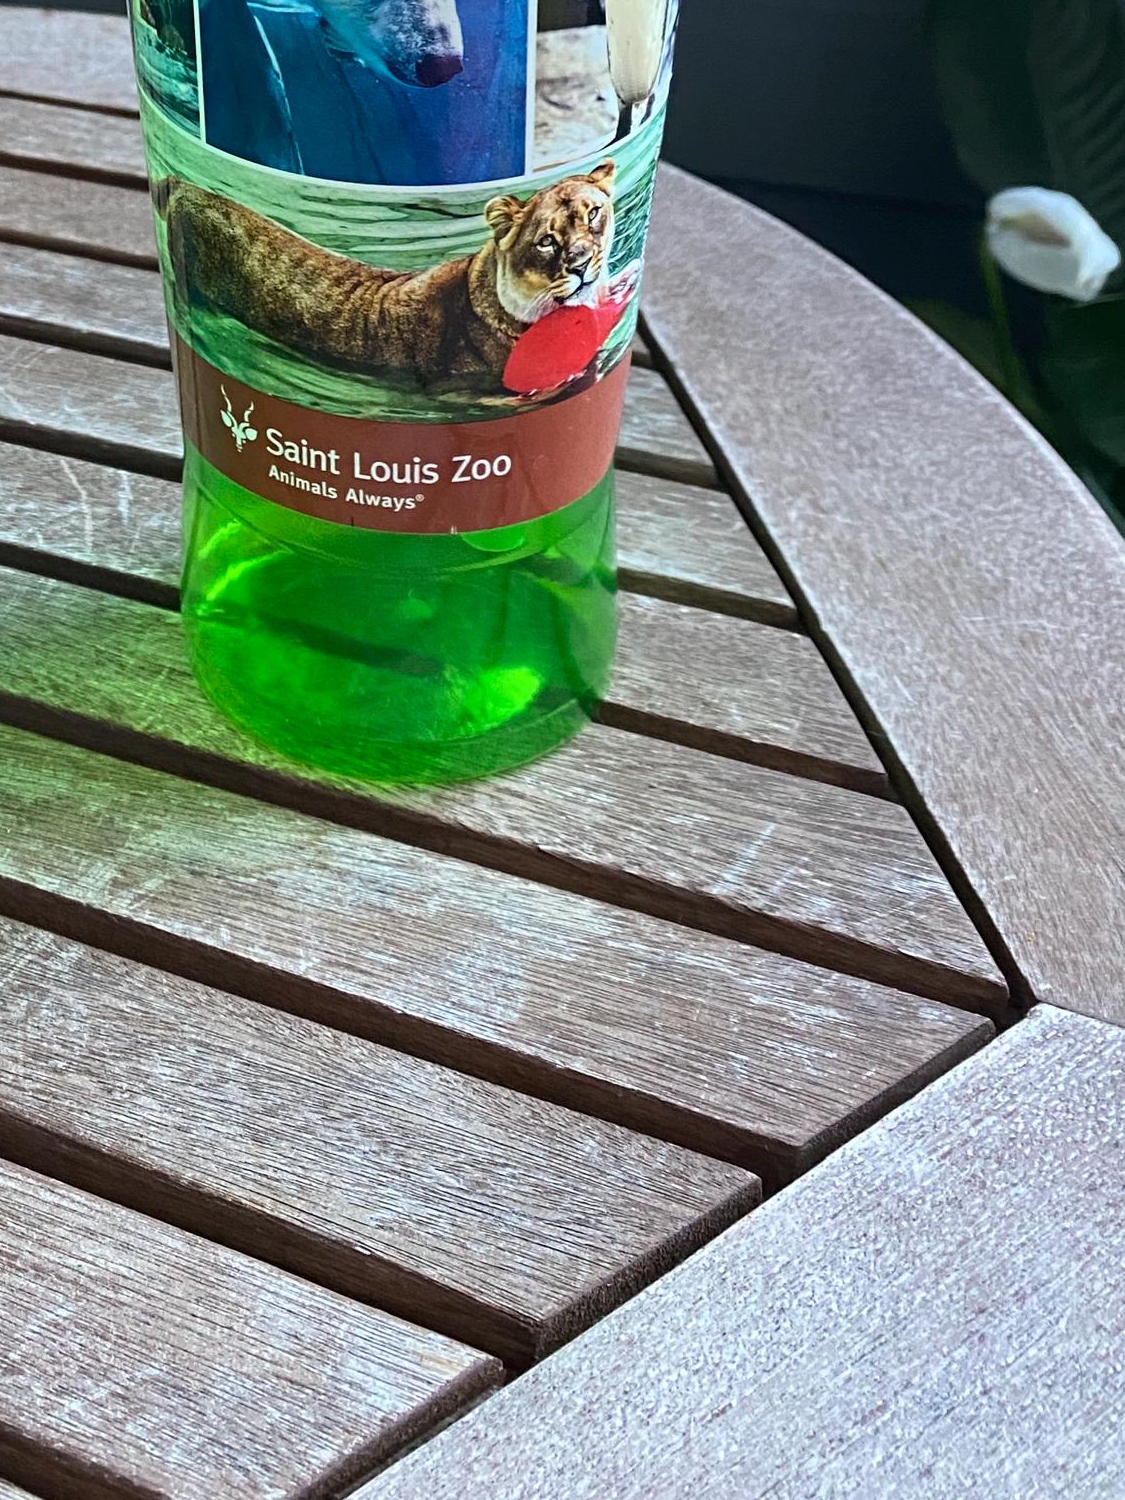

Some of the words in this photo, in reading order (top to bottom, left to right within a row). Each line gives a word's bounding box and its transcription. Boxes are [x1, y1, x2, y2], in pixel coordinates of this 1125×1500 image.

[266, 428, 340, 475] Saint
[353, 451, 439, 485] Louis
[451, 454, 512, 484] Zoo
[268, 465, 338, 499] Animals
